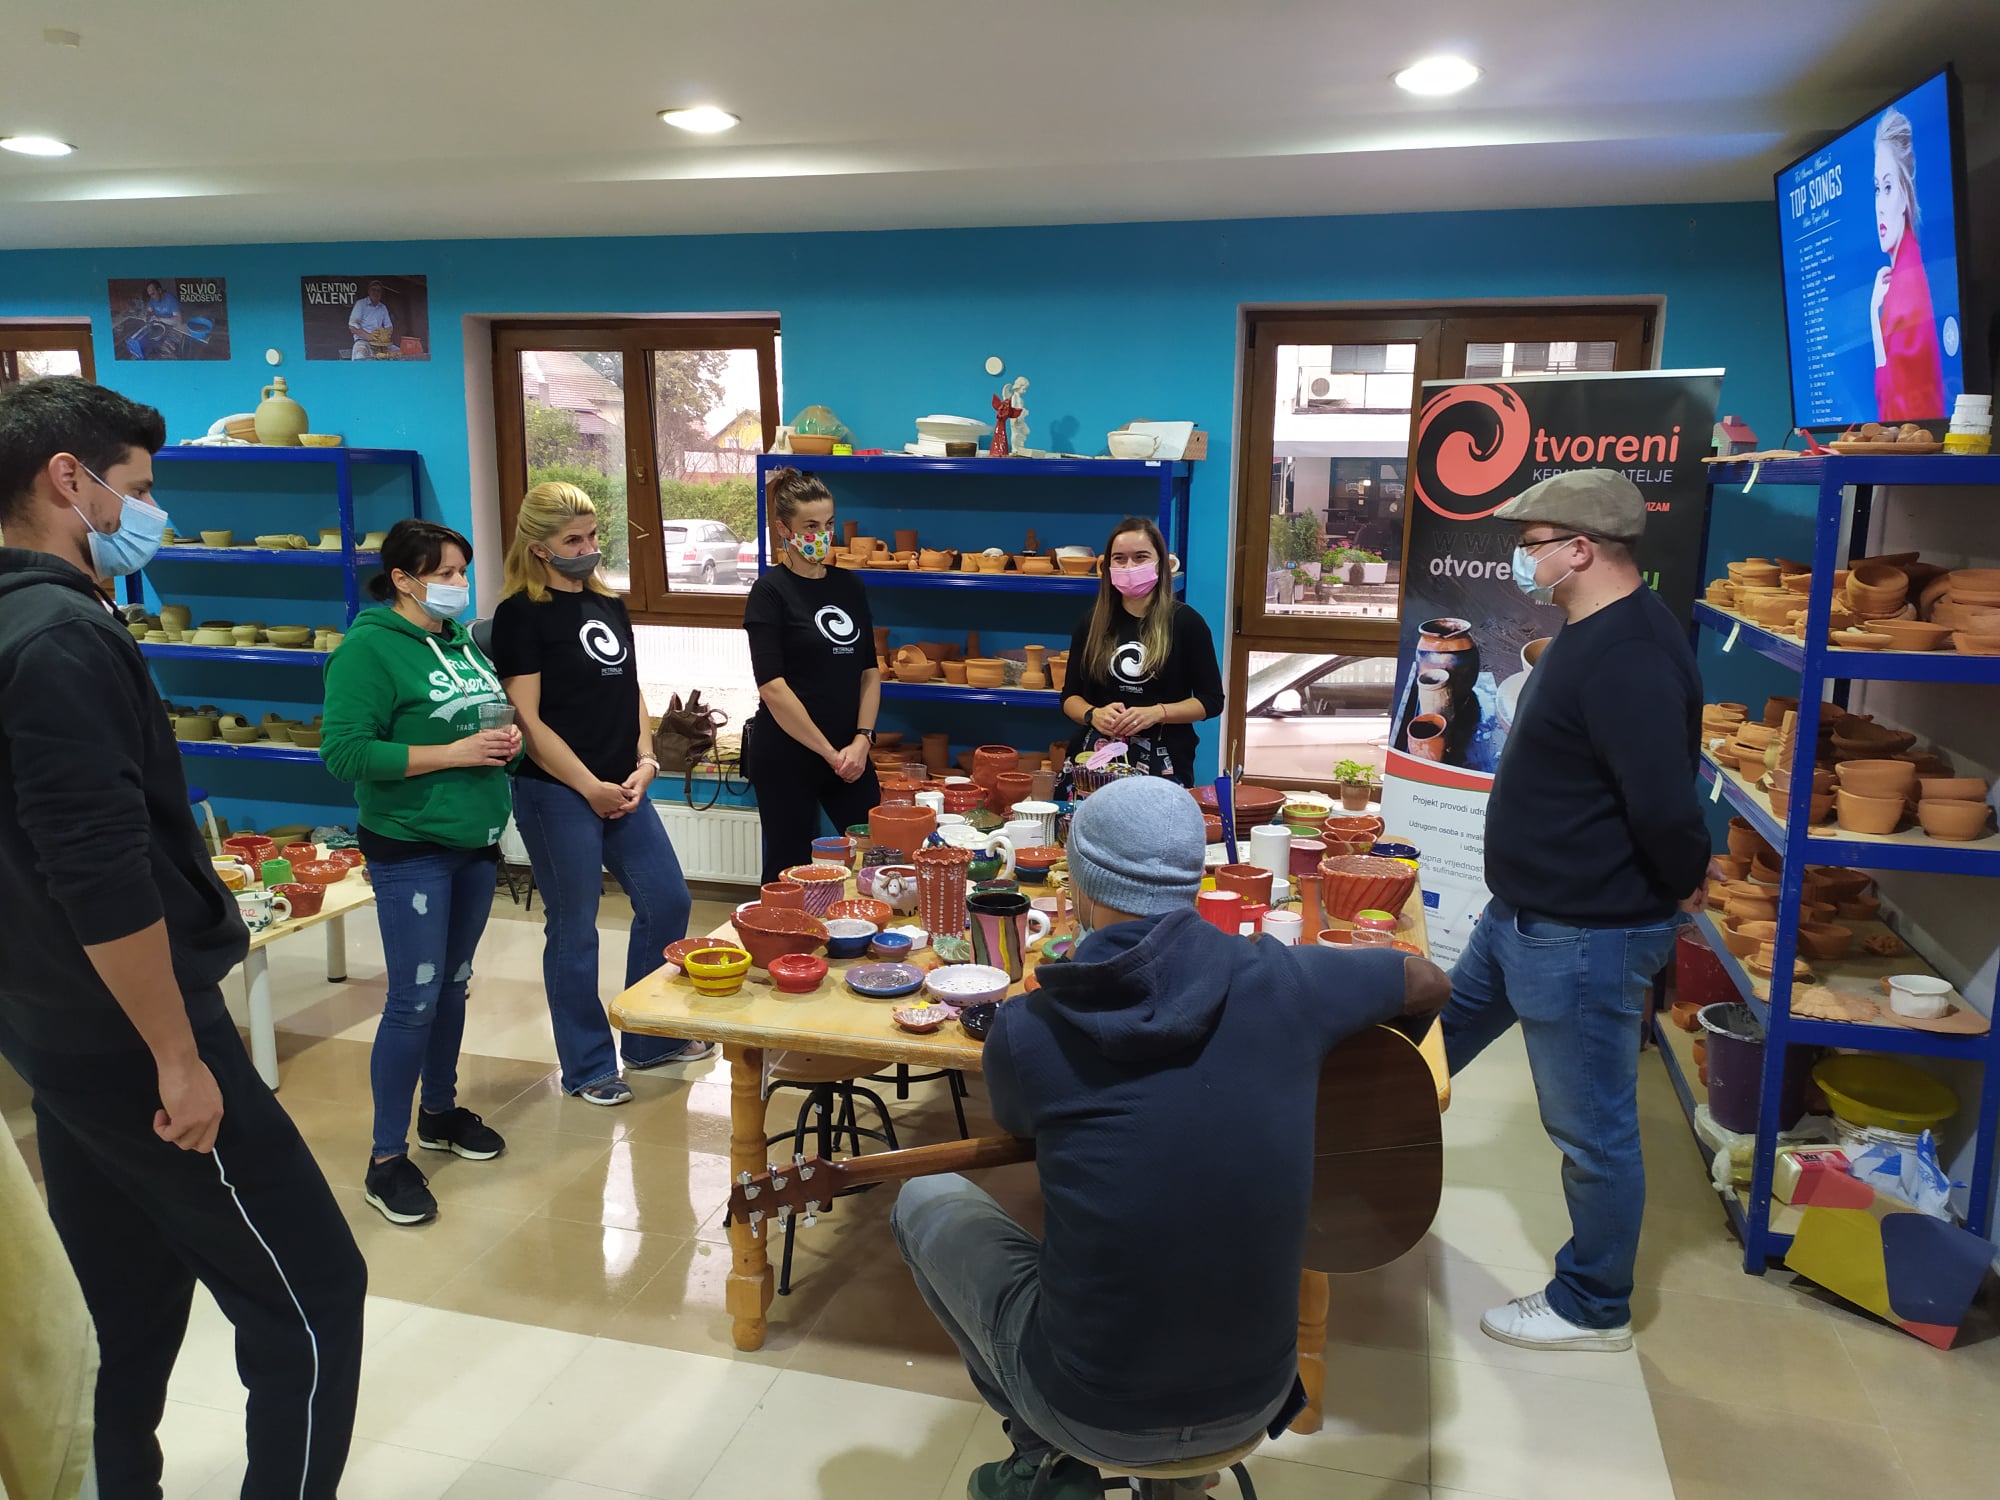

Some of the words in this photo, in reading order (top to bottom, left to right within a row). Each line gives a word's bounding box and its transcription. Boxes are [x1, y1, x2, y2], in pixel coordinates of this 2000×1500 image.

[1790, 184, 1807, 220] TOP
[1809, 164, 1843, 210] SONGS
[180, 282, 217, 295] SILVIO
[304, 282, 358, 293] VALENTINO
[307, 292, 357, 305] VALENT
[1620, 469, 1673, 483] ATELJE
[1645, 502, 1670, 512] IZAM
[1429, 554, 1516, 581] otvore
[1413, 795, 1438, 808] Projekt
[1440, 801, 1468, 813] provodi
[1470, 808, 1486, 817] udru
[1409, 820, 1437, 832] Udrugom
[1439, 827, 1459, 837] osoba
[1464, 845, 1484, 855] udrug
[1444, 859, 1484, 873] vrijednost
[1433, 866, 1482, 882] sufinancirano
